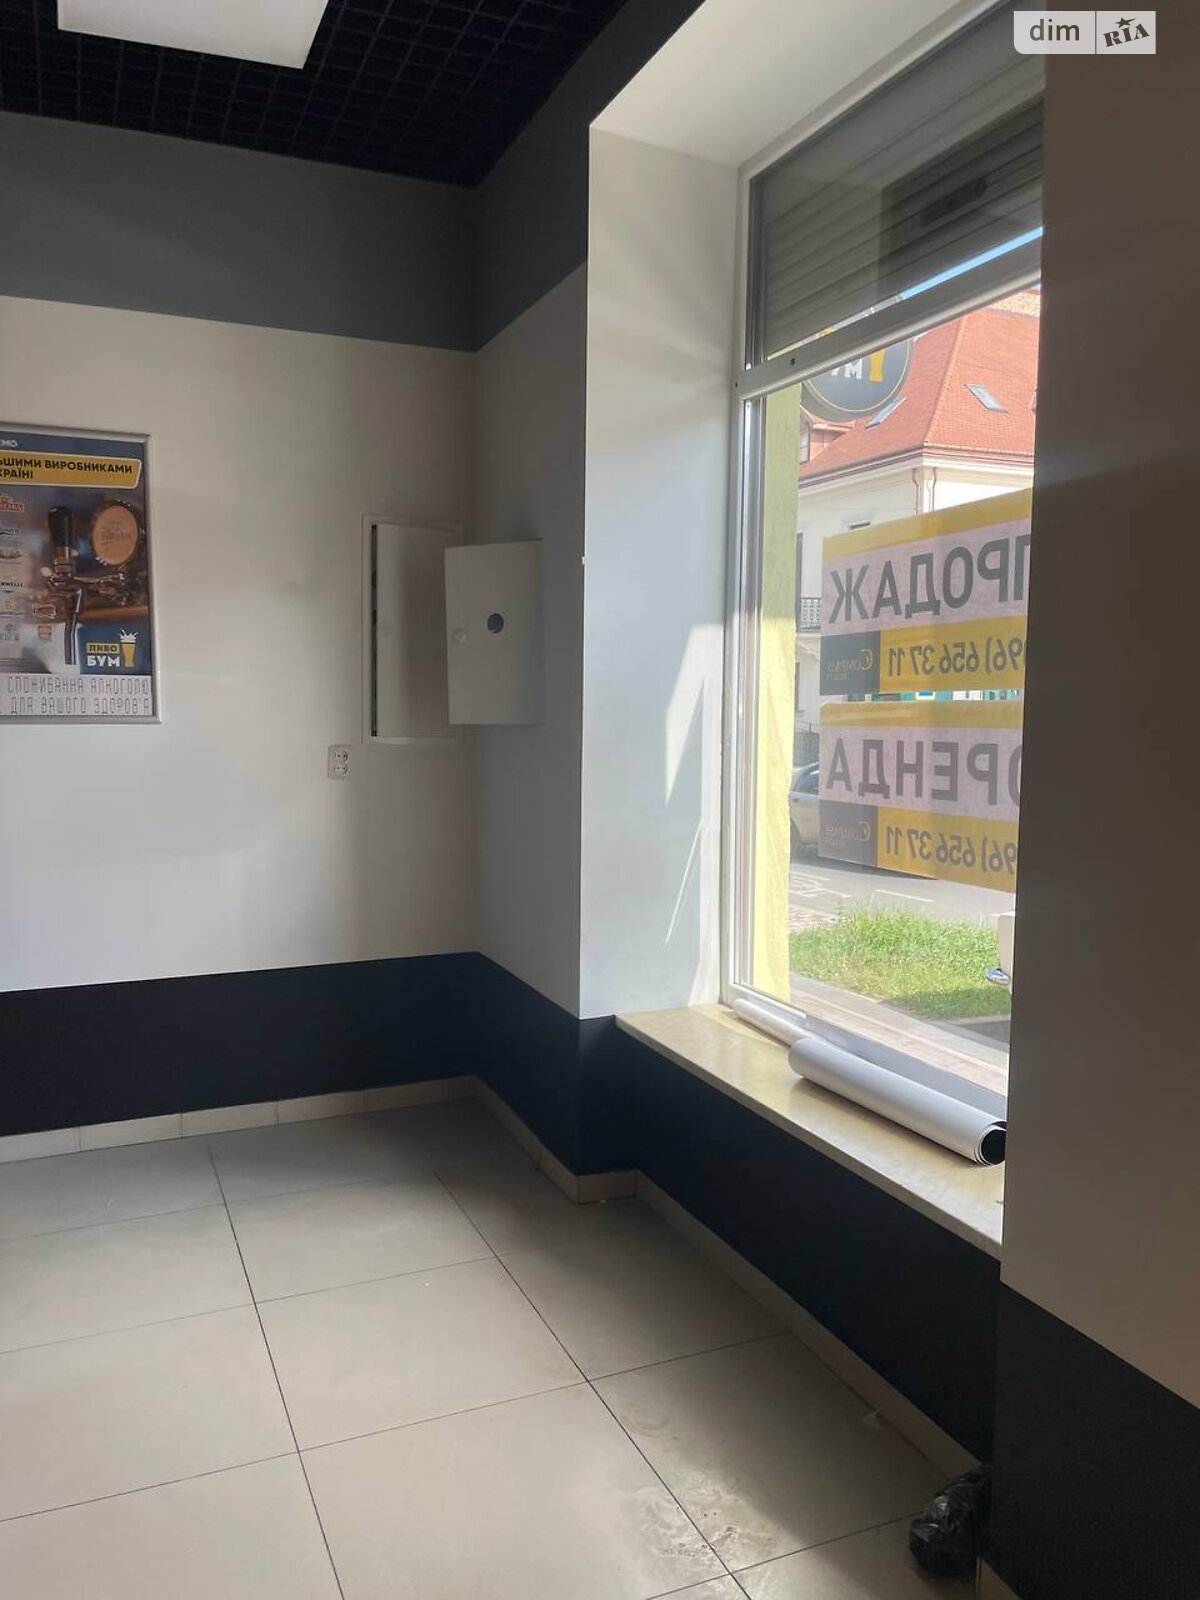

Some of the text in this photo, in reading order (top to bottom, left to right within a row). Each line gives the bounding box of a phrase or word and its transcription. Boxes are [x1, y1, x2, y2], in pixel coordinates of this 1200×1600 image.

[45, 459, 132, 474] ВИРОБНИКАМИ
[88, 644, 118, 653] ПИВО
[87, 656, 120, 667] БУМ
[11, 696, 33, 714] ДЛЯ
[41, 697, 87, 714] ВАШОГО
